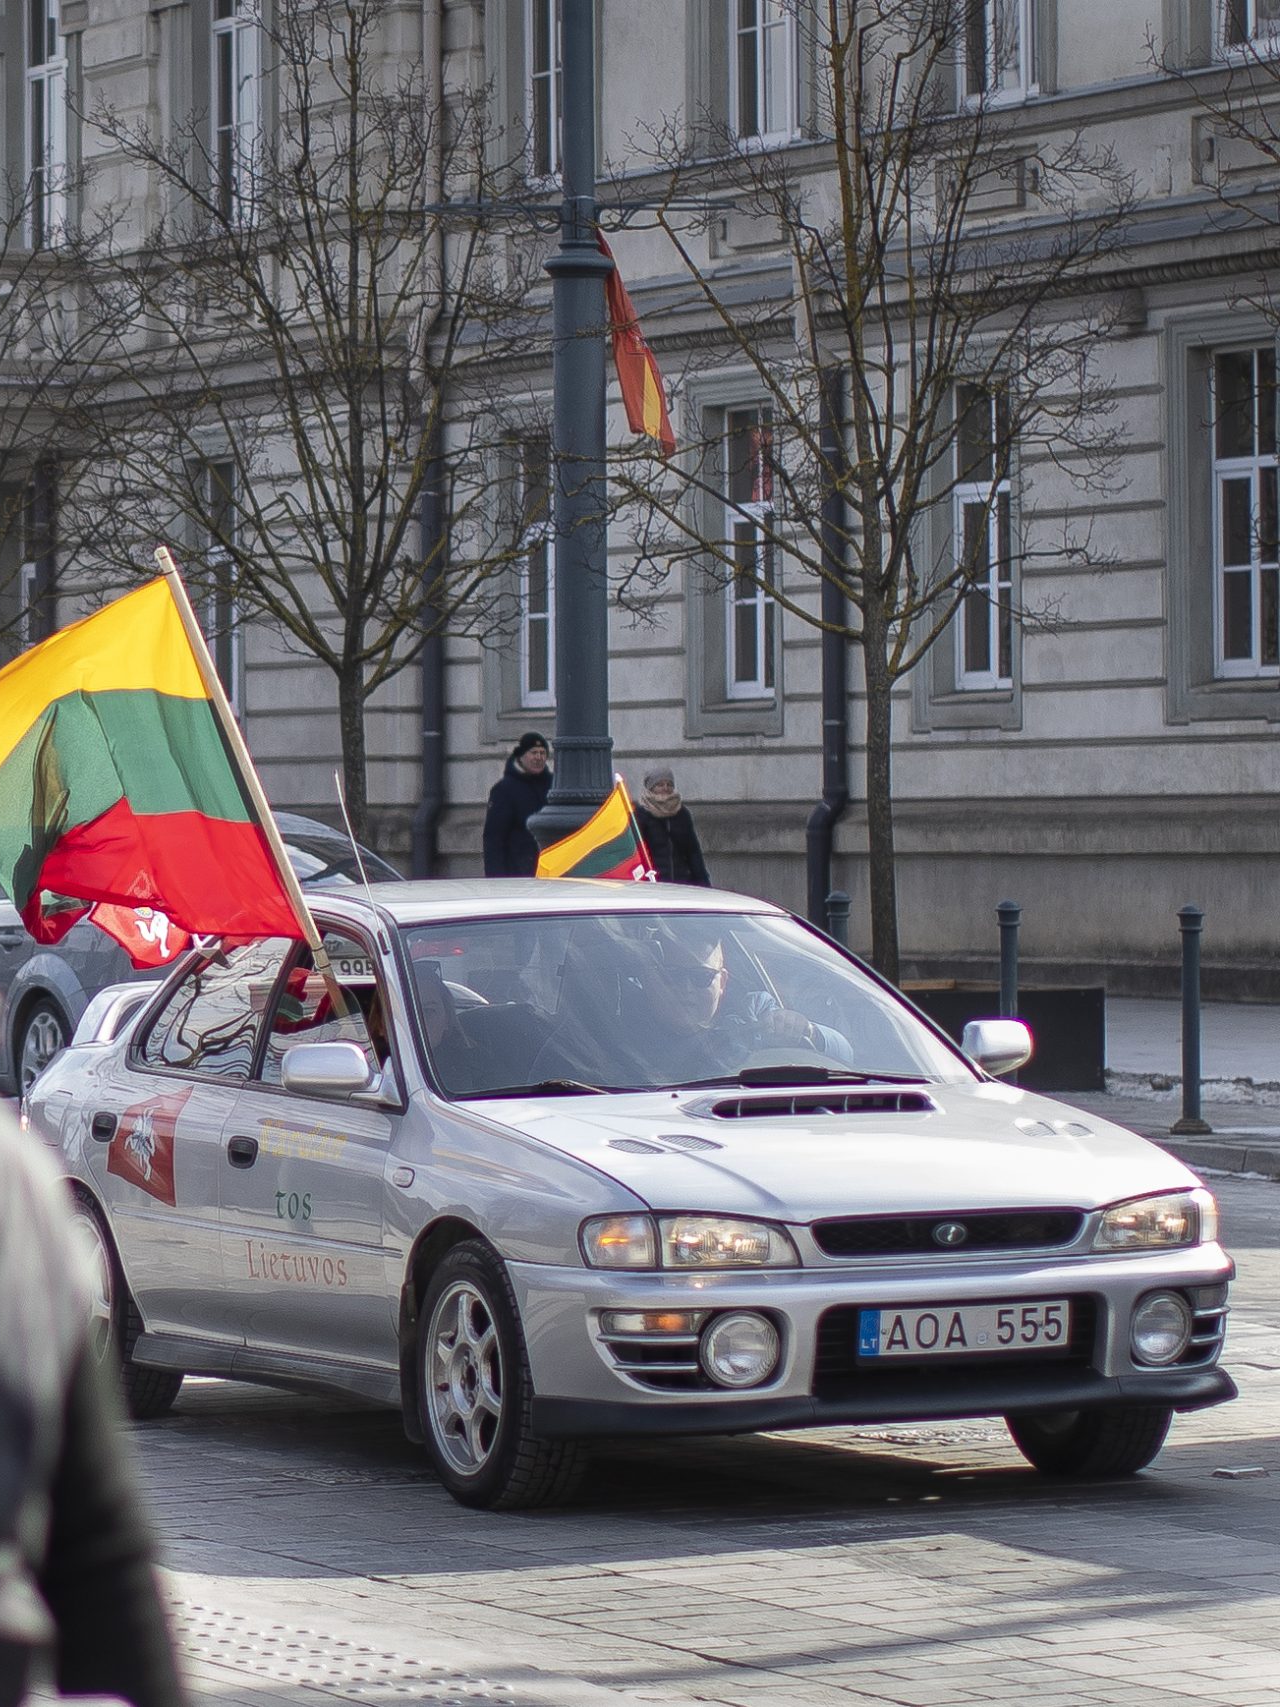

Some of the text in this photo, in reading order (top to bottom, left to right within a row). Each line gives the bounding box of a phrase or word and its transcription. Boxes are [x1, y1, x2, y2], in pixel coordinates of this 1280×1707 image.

[275, 1190, 312, 1220] tos
[245, 1239, 348, 1286] Lietuvos
[861, 1338, 878, 1349] LT
[885, 1305, 1062, 1350] AOA 555
